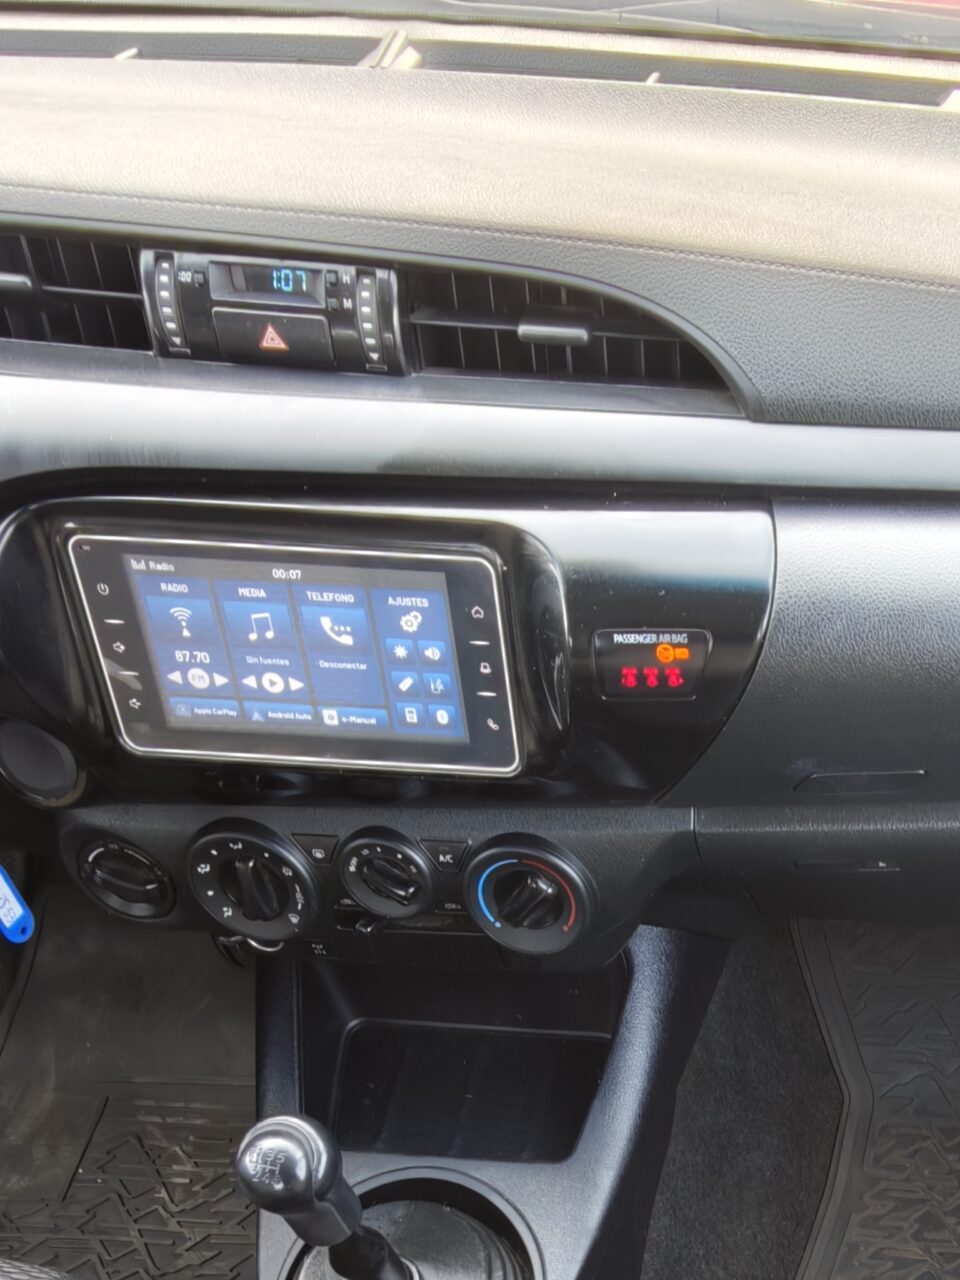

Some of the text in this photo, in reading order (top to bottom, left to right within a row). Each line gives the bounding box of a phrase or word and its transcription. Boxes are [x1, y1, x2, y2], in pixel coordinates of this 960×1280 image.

[271, 268, 307, 292] 1:07
[149, 559, 175, 572] Radio
[272, 569, 302, 580] 00:07
[160, 582, 189, 593] RADIO
[238, 586, 267, 598] MEDIA
[306, 591, 355, 603] TELEFONO
[388, 596, 429, 607] AJUSTES
[613, 633, 658, 644] PASSENGER
[174, 650, 211, 664] 87.70
[193, 706, 238, 718] Apple CarPlay
[341, 715, 377, 726] e-Manual
[438, 853, 454, 864] A/C
[276, 1152, 287, 1163] 5
